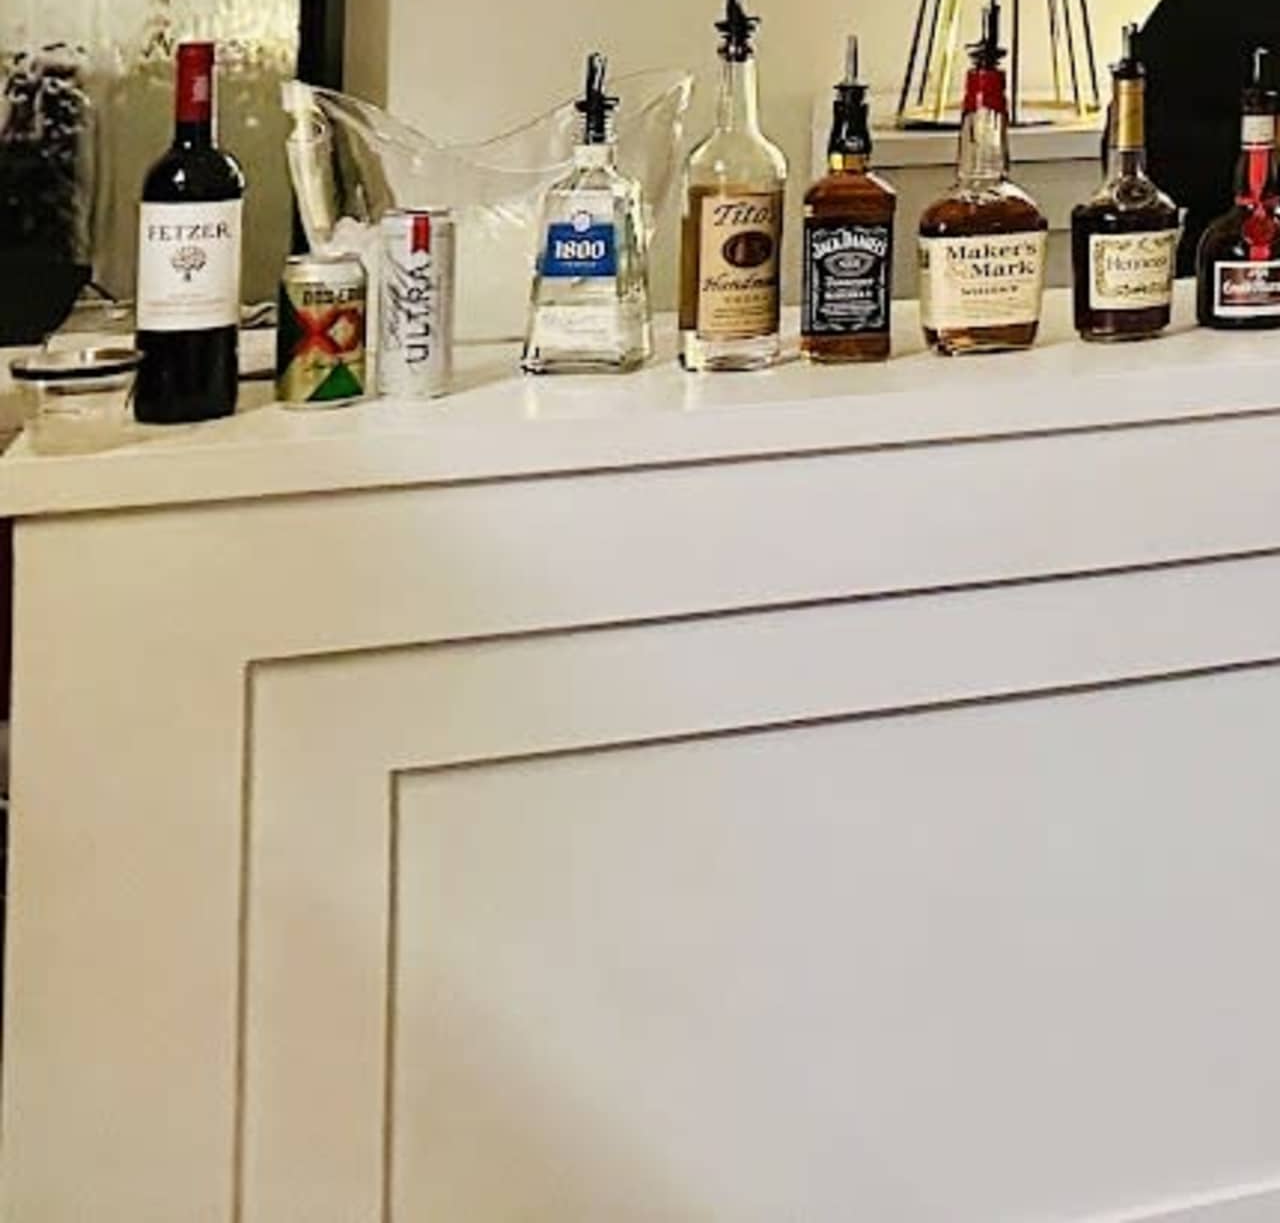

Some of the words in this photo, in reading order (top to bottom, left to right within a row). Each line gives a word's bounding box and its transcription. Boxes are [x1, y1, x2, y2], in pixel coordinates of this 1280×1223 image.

[147, 222, 232, 242] FETZER
[554, 240, 606, 260] 1800
[945, 242, 1037, 260] Maker's
[971, 260, 1035, 277] Mark
[405, 260, 432, 364] ULTRA
